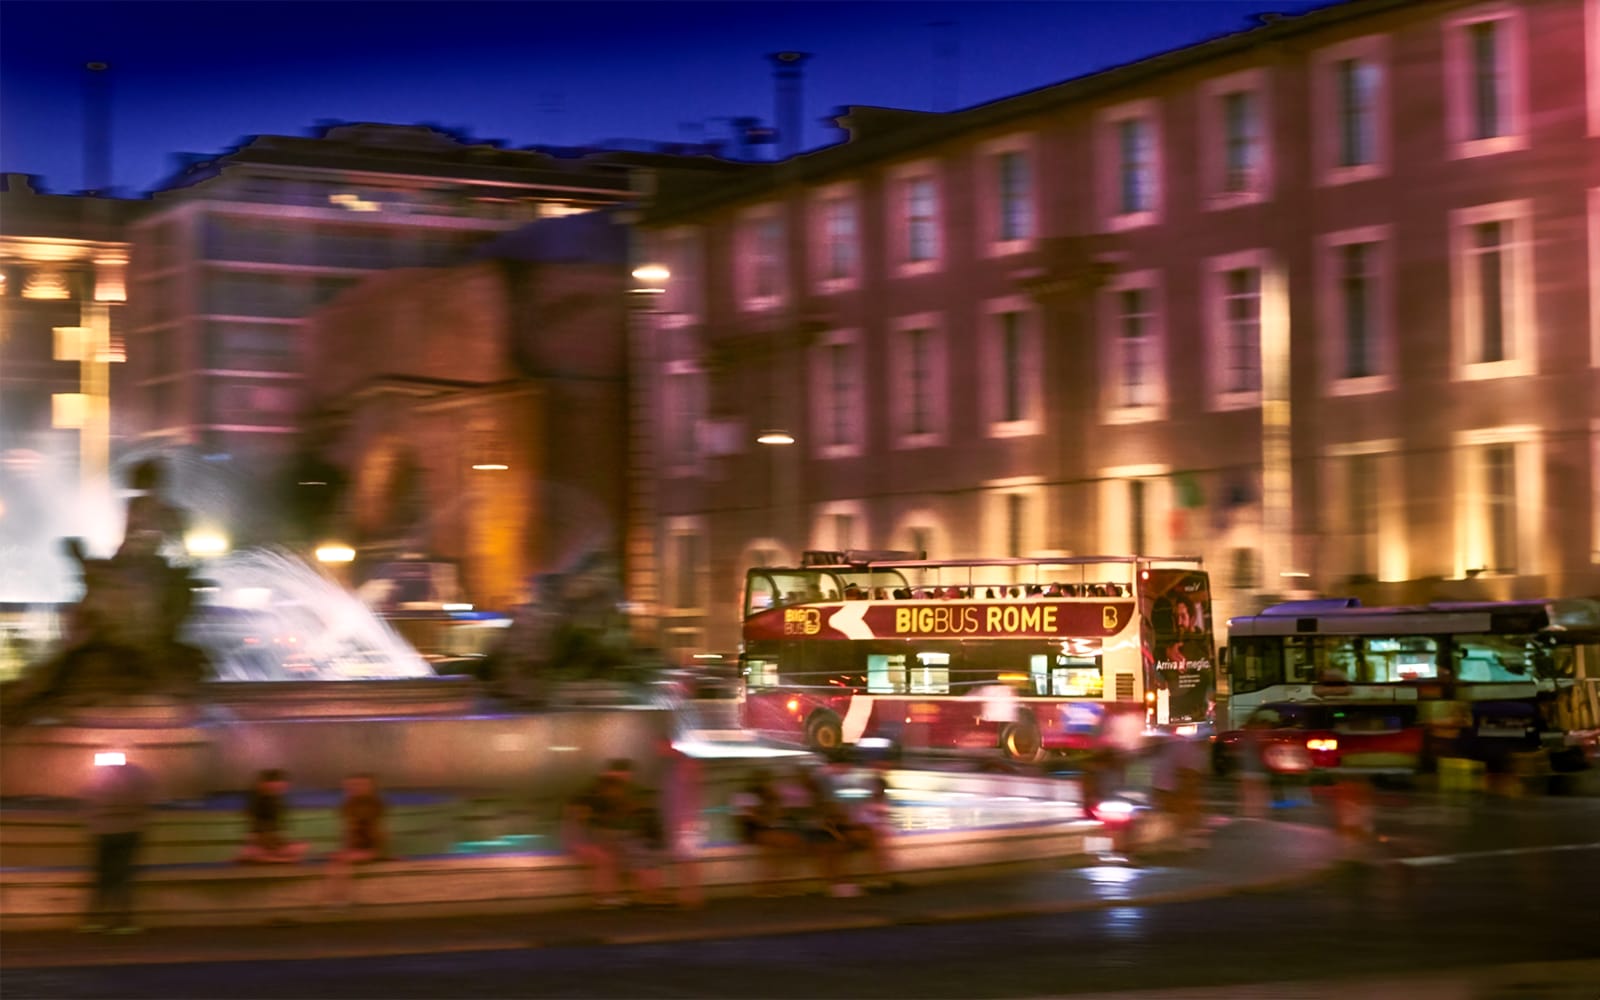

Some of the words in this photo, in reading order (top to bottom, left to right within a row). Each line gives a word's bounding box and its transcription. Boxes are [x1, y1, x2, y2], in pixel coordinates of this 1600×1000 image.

[784, 609, 806, 622] BIG
[987, 606, 1058, 633] ROME
[1156, 659, 1178, 671] Arriva
